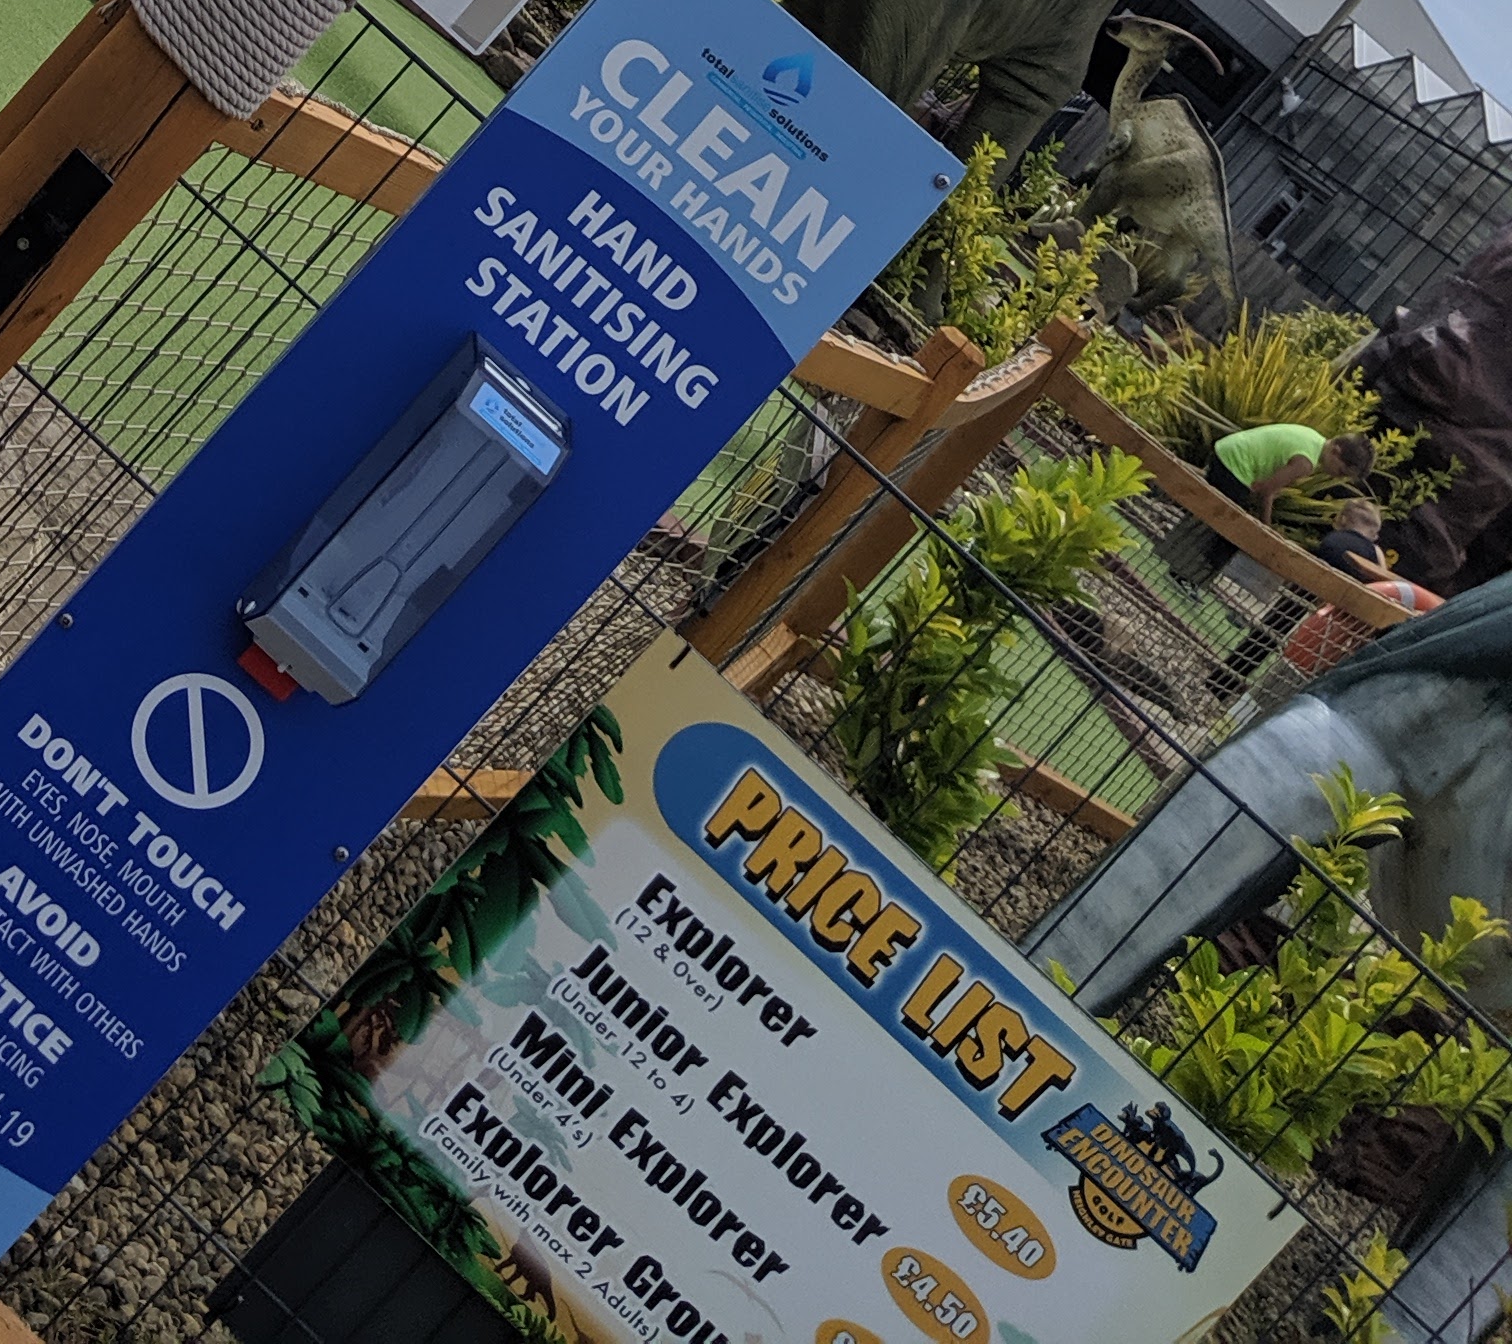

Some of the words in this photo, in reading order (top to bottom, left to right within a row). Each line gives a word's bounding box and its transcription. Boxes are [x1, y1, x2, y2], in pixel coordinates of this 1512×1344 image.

[569, 84, 673, 191] YOUR
[669, 179, 808, 305] HANDS
[600, 38, 856, 273] CLEAN
[473, 186, 720, 410] SANITISING
[566, 189, 698, 311] HAND
[464, 256, 651, 427] STATION
[17, 712, 129, 817] DON'T
[127, 810, 246, 931] TOUCH
[21, 768, 68, 822] EYES,
[65, 810, 119, 870] NOSE,
[116, 858, 187, 927] MOUTH
[28, 819, 126, 916] UNWASHED
[120, 908, 187, 972] HANDS
[29, 946, 80, 1000] WITH
[74, 991, 145, 1059] OTHERS
[614, 907, 653, 944] (12
[652, 942, 670, 964] &
[672, 960, 724, 1013] Over)
[635, 872, 818, 1047] Explorer
[704, 767, 922, 987] PRICE
[899, 953, 1076, 1122] LIST
[487, 1046, 554, 1110] (Under
[550, 977, 618, 1040] (Under
[621, 1040, 647, 1070] 12
[646, 1068, 667, 1090] to
[669, 1093, 695, 1116] 4)
[569, 944, 709, 1077] Junior
[706, 1069, 890, 1246] Explorer
[444, 1081, 625, 1257] Explorer
[509, 1010, 614, 1120] Mini
[607, 1107, 790, 1283] Explorer
[957, 1181, 1046, 1268] £5.40
[1057, 1127, 1194, 1258] ENCOUNTER
[1090, 1122, 1196, 1224] DINOSAUR
[1092, 1195, 1125, 1226] GOLF
[422, 1116, 499, 1192] (Family
[494, 1183, 530, 1223] with
[532, 1223, 574, 1264] max
[574, 1260, 593, 1280] 2
[591, 1281, 660, 1344] Adults)
[890, 1254, 979, 1339] £4.50
